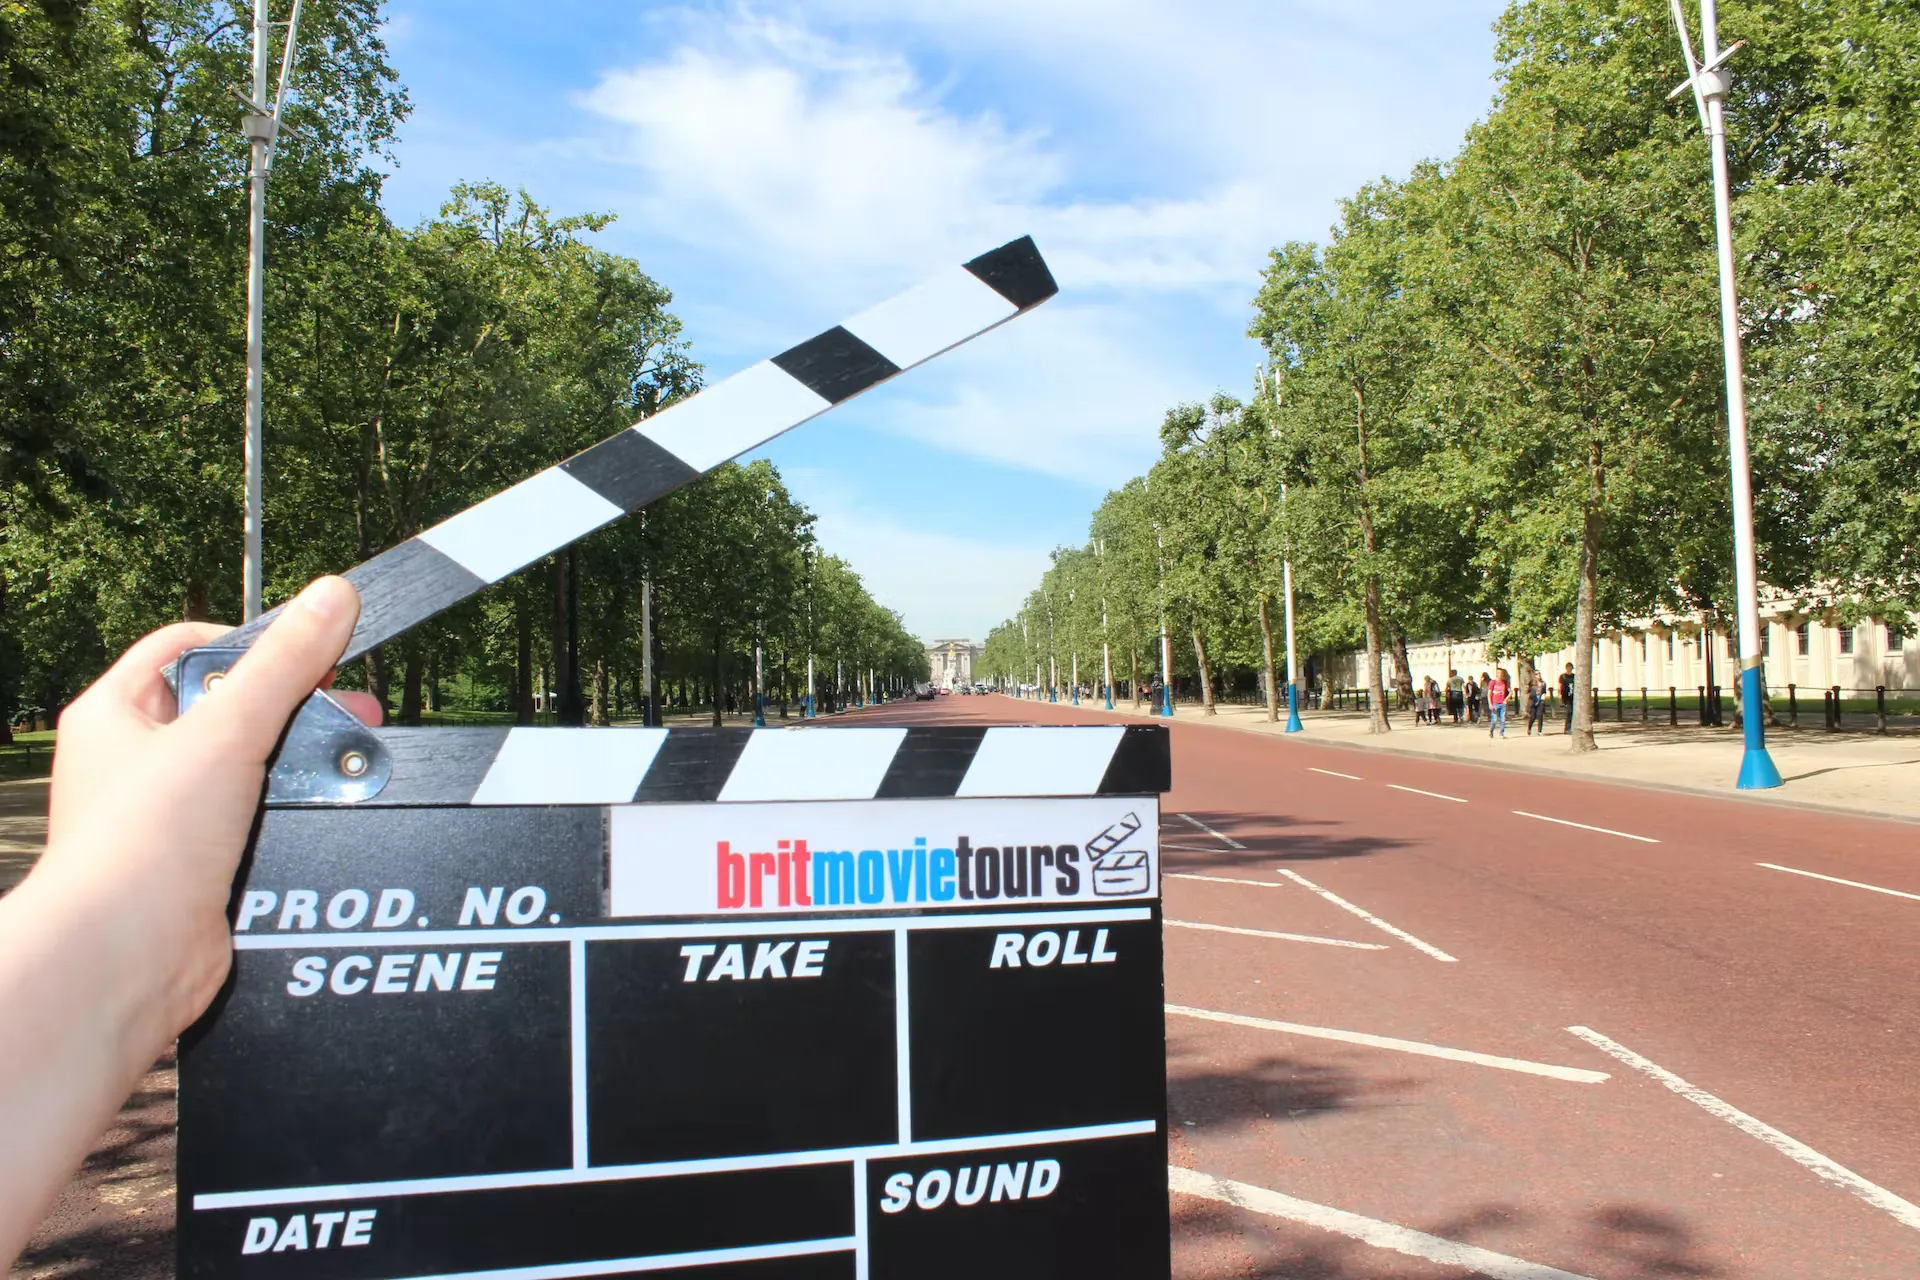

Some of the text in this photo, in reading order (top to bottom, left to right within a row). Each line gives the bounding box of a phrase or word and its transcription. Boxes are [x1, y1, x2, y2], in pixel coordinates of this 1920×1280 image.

[234, 885, 562, 932] PROD. NO.
[679, 940, 830, 983] TAKE
[989, 928, 1118, 969] ROLL
[286, 951, 503, 998] SCENE
[880, 1159, 1061, 1214] SOUND
[241, 1209, 377, 1255] DATE
